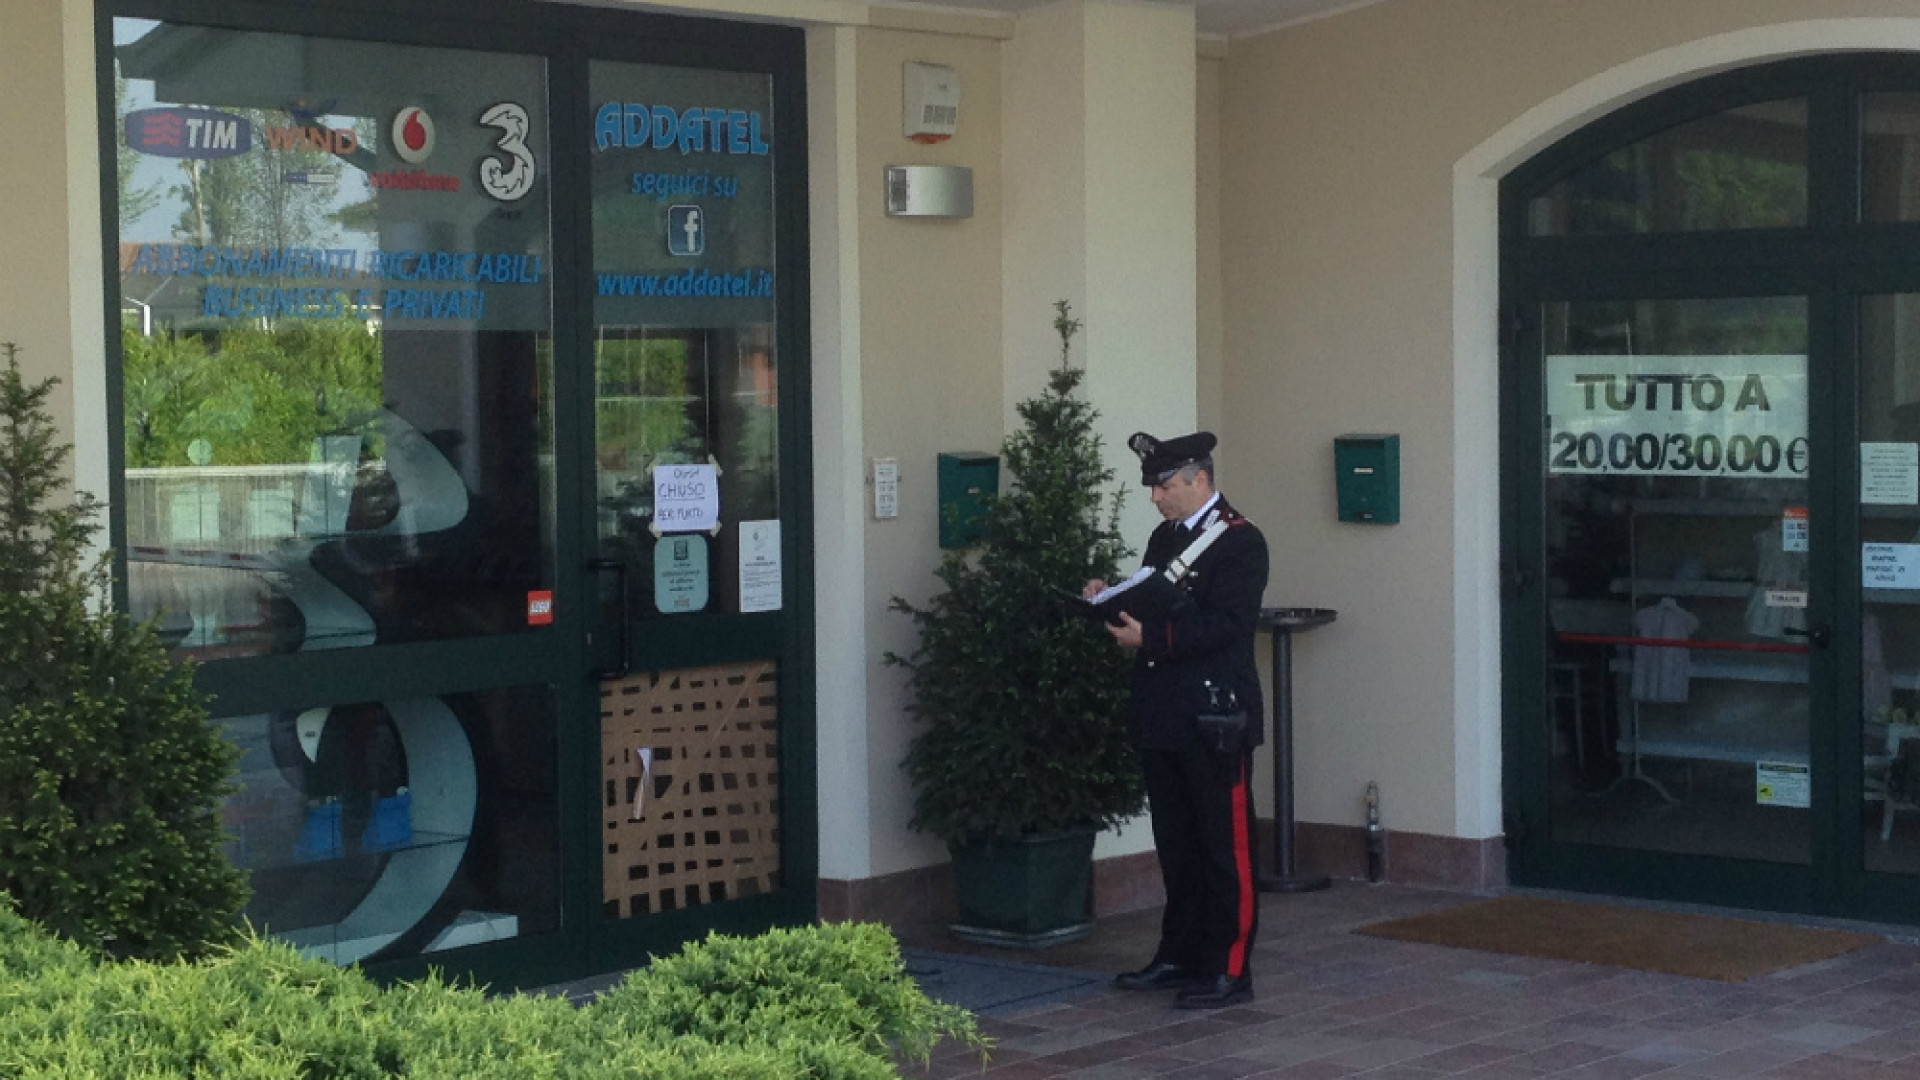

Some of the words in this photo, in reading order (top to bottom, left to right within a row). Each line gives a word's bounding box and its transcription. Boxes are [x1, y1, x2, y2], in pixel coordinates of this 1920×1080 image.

[185, 118, 238, 150] TIM
[265, 126, 358, 154] WIND
[594, 102, 769, 156] ADDATEL
[632, 169, 707, 201] seguici
[714, 174, 738, 197] su
[132, 244, 358, 280] ABBONAMENTI
[369, 249, 542, 284] RICARICABILI
[596, 267, 774, 298] www.addatel.it
[203, 285, 345, 319] BUSINESS
[384, 288, 486, 320] PRIVATI
[1575, 373, 1725, 411] TUTTO
[1733, 373, 1771, 411] A
[658, 482, 705, 498] CHIUSO
